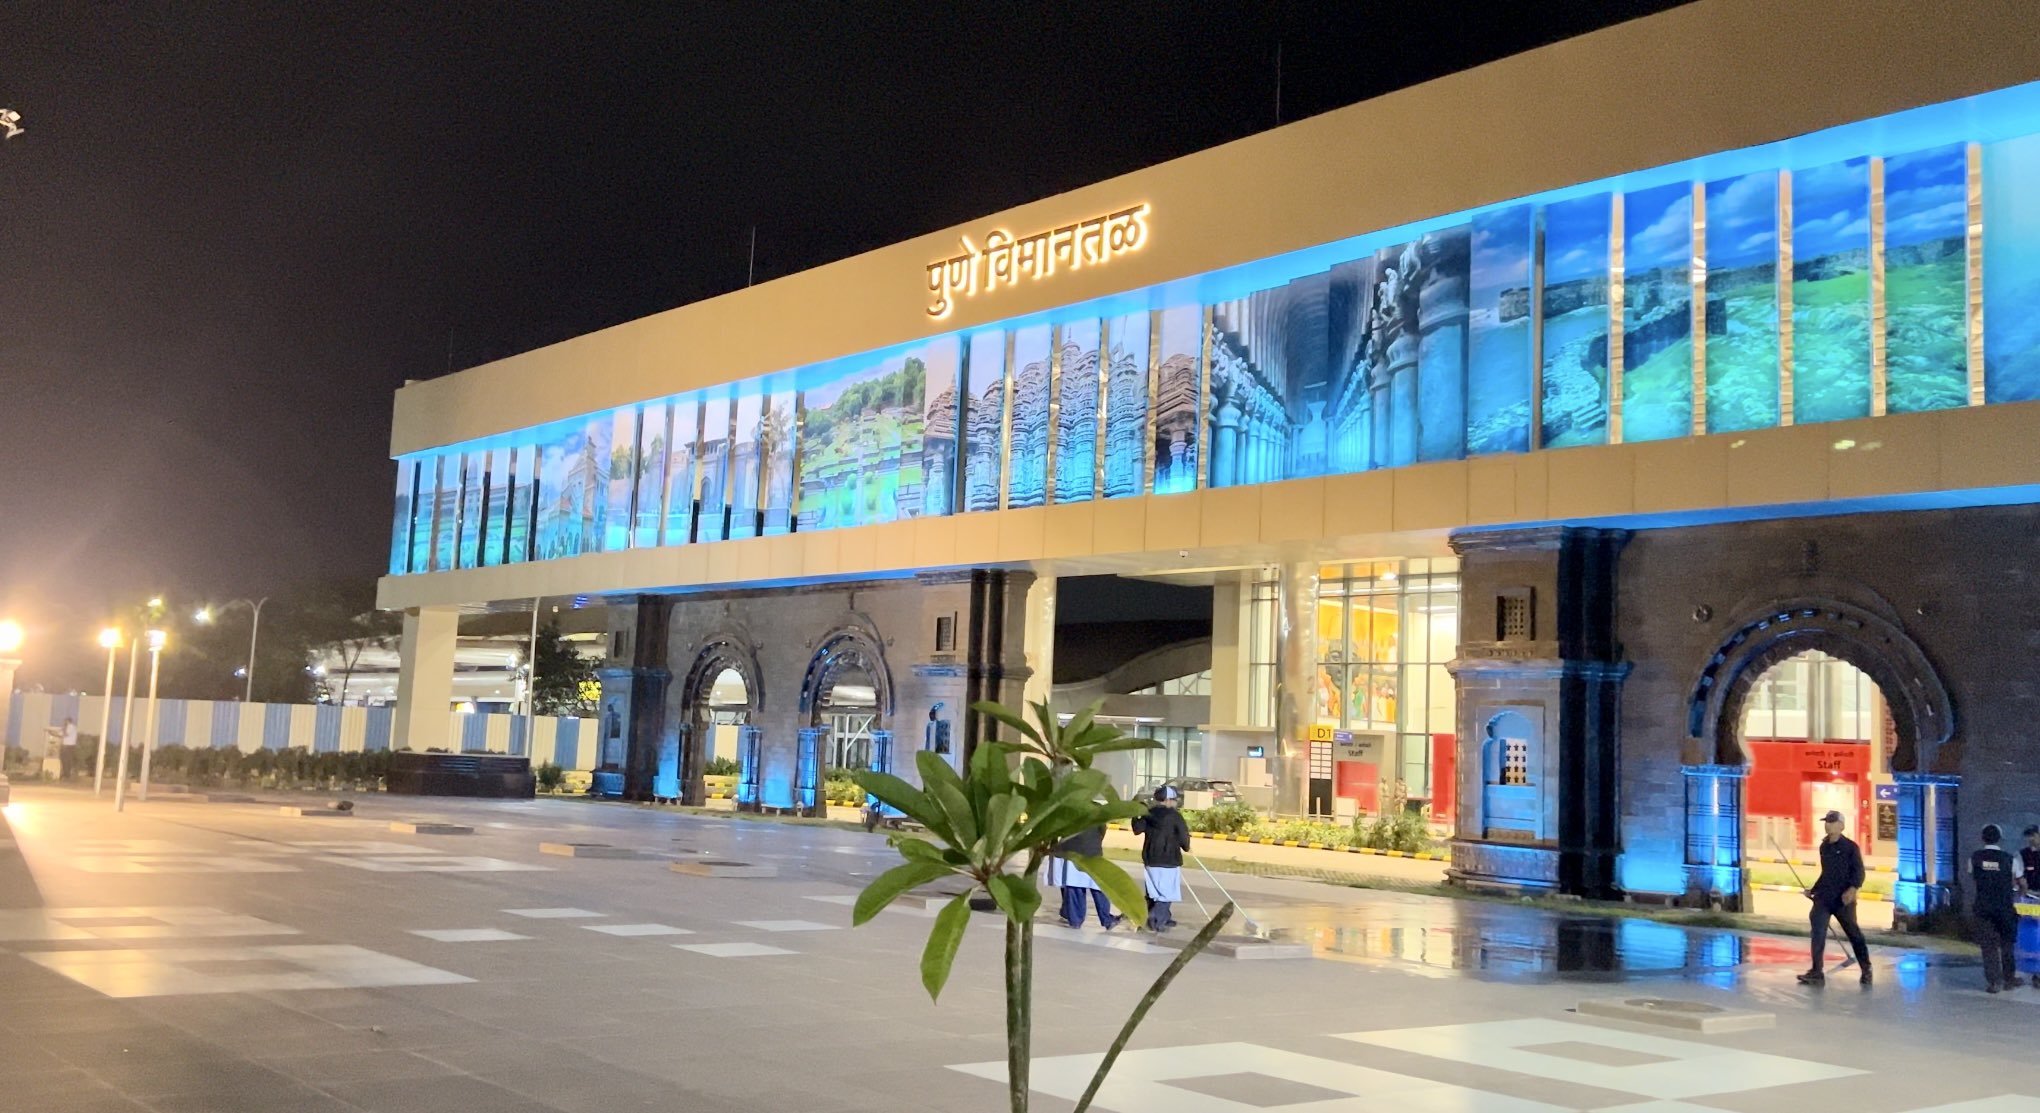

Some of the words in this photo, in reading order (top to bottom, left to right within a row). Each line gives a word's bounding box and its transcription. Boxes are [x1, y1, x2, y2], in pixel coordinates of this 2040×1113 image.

[926, 235, 981, 317] पुणे
[982, 203, 1151, 290] विमानतळ
[1317, 728, 1331, 739] D1
[1817, 760, 1841, 769] Staff
